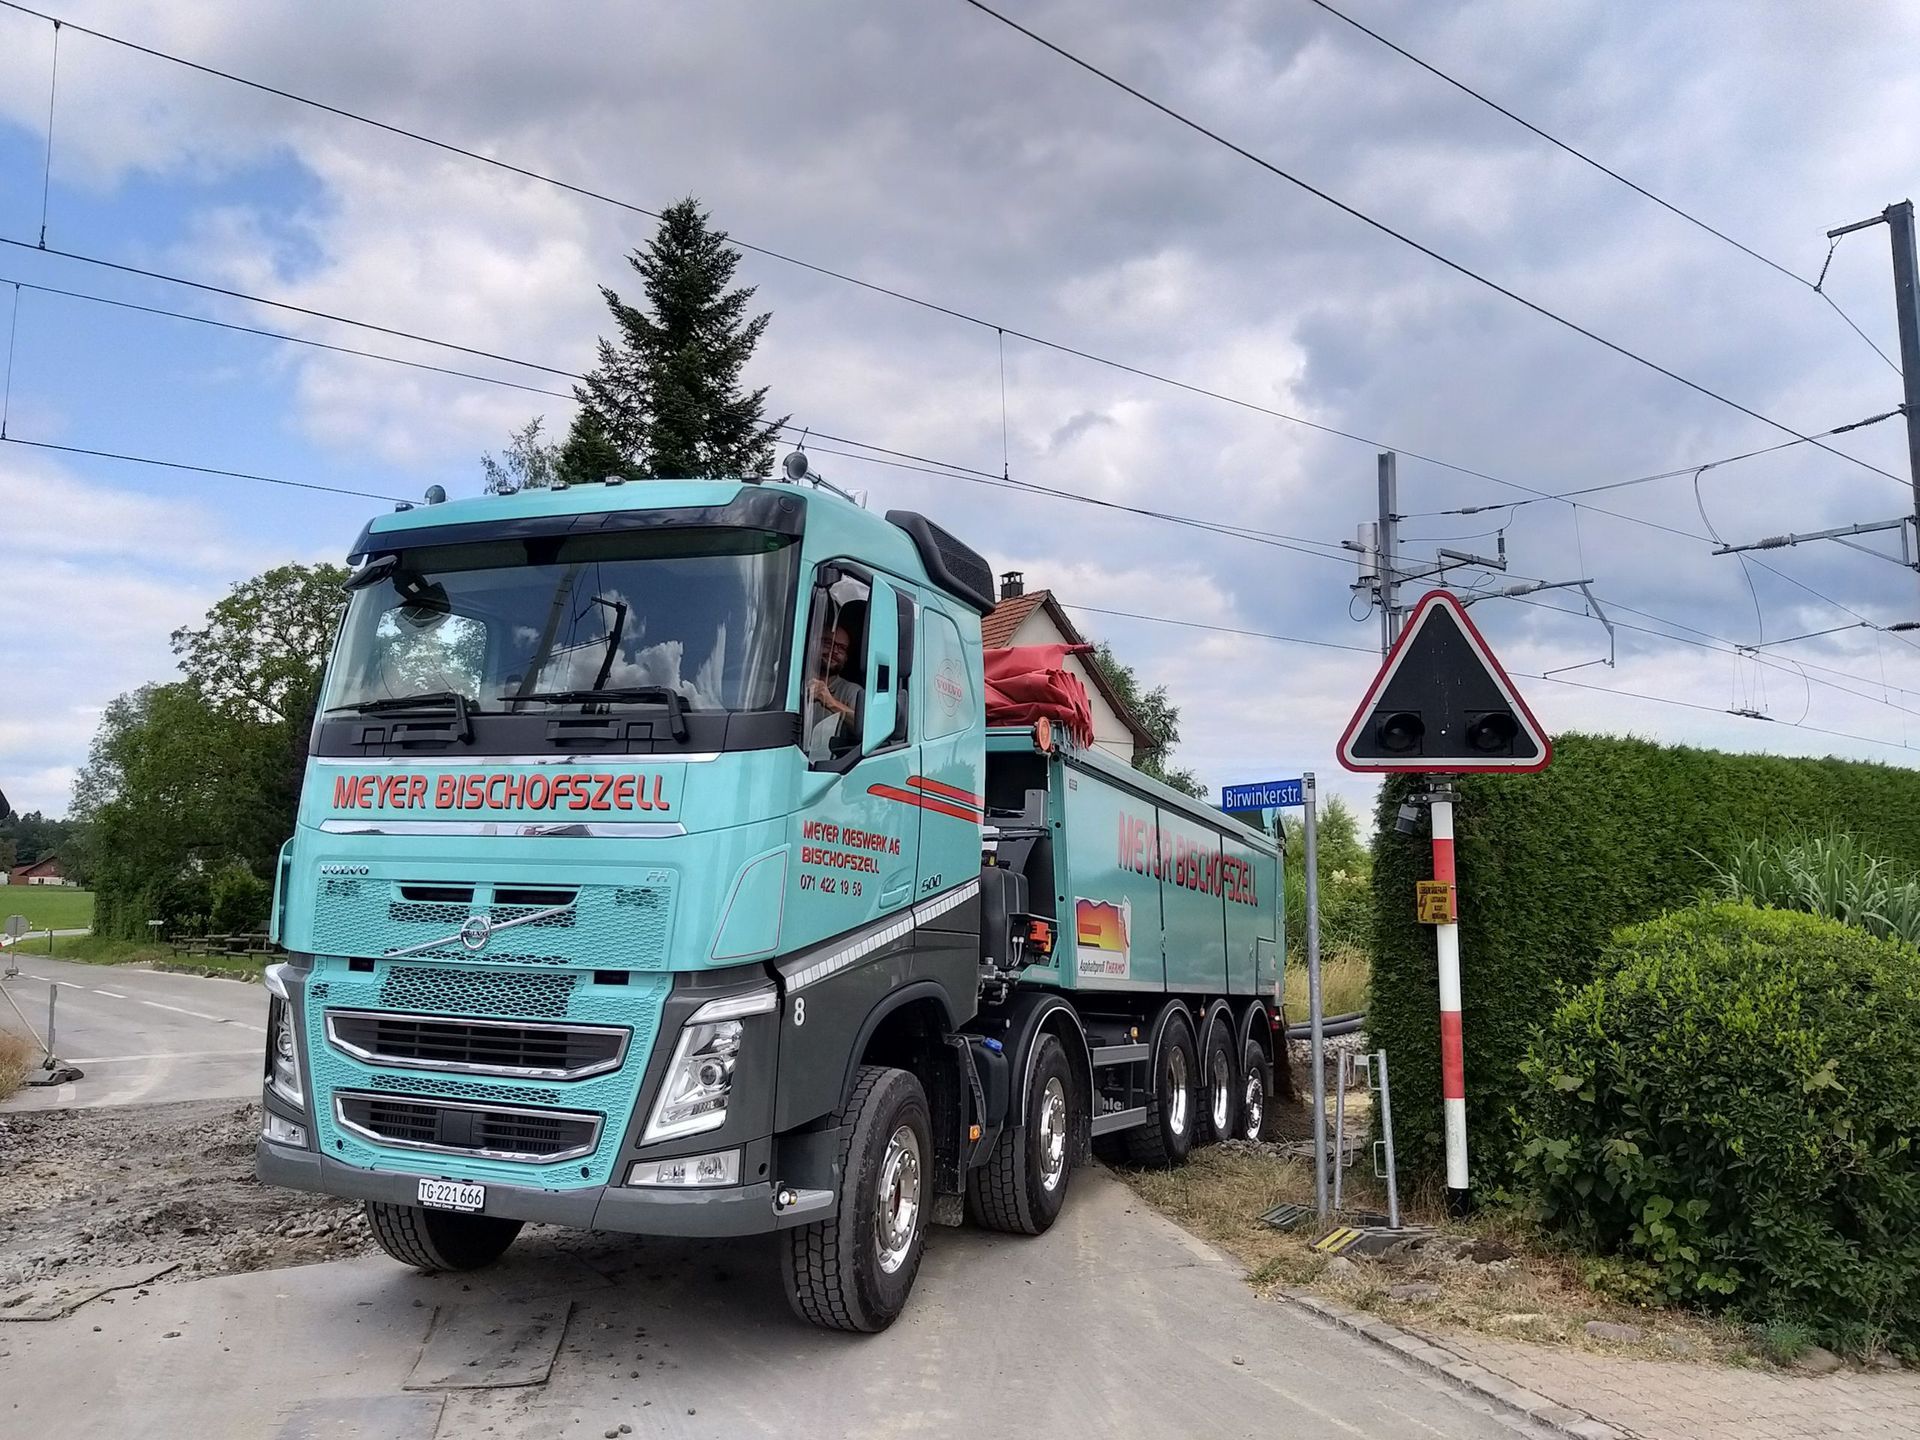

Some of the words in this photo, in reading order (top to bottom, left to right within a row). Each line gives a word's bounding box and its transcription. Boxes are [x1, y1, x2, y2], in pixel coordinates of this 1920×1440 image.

[935, 677, 962, 698] VOLVO
[333, 775, 428, 810] MEYER
[434, 774, 671, 811] BISCHOFSZELL
[1226, 785, 1301, 808] Birwinkerstr.
[803, 820, 840, 844] MEYER
[841, 828, 888, 853] KIESWERK
[889, 837, 901, 855] AG
[320, 863, 370, 876] VOLVO
[801, 846, 880, 874] BISCHOFSZELL
[1117, 811, 1173, 884] MEYER
[1175, 834, 1258, 908] BISCHOFSZELL
[645, 870, 671, 883] FH
[800, 874, 816, 891] 071
[820, 877, 836, 893] 422
[840, 880, 849, 895] 19
[852, 881, 863, 896] 59
[921, 873, 942, 893] 500
[793, 997, 806, 1027] 8
